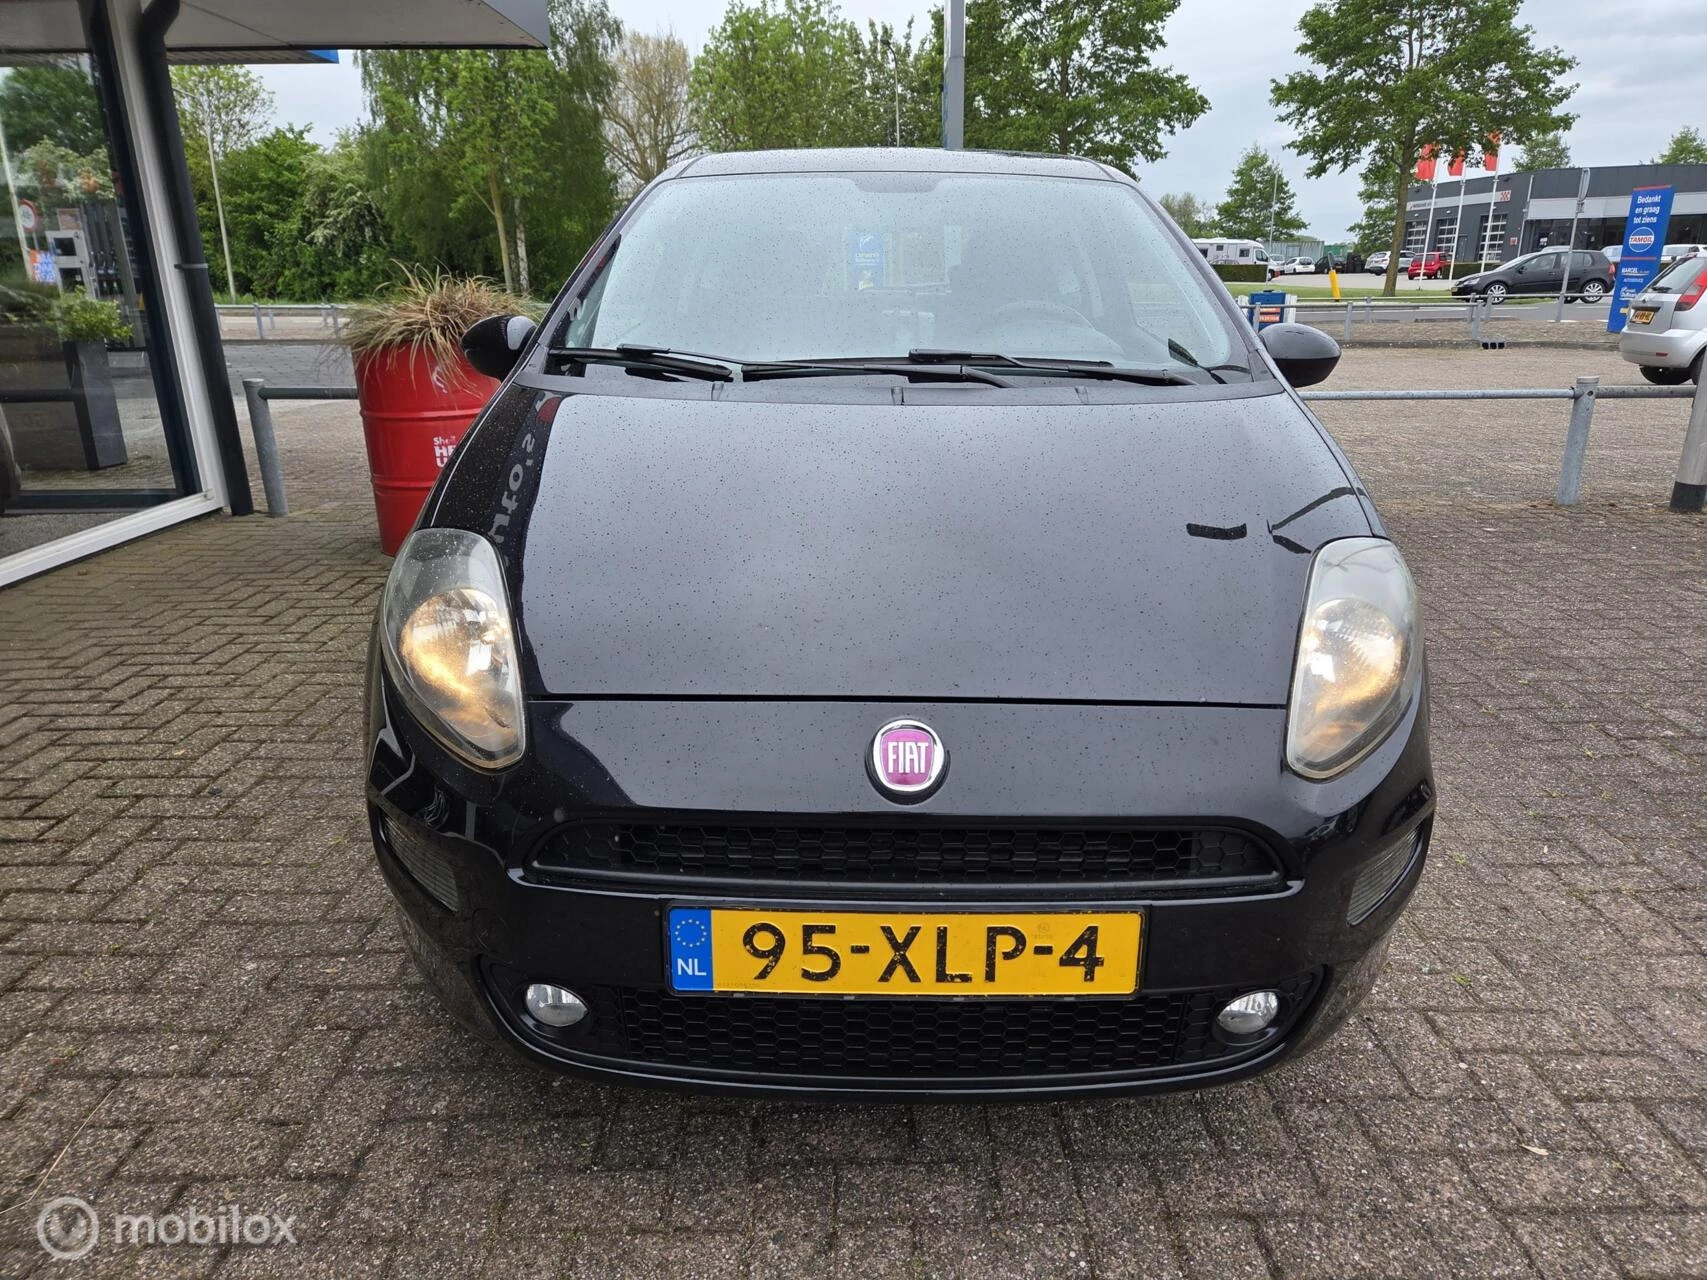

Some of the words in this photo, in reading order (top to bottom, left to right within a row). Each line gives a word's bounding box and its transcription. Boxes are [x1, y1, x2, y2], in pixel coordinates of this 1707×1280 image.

[1637, 195, 1661, 204] Bedankt
[1643, 206, 1660, 215] graag
[1633, 216, 1642, 224] tot
[1641, 215, 1657, 223] ziens
[887, 741, 929, 774] FIAT
[742, 922, 1105, 984] 95-XLP-4
[676, 958, 707, 976] NL
